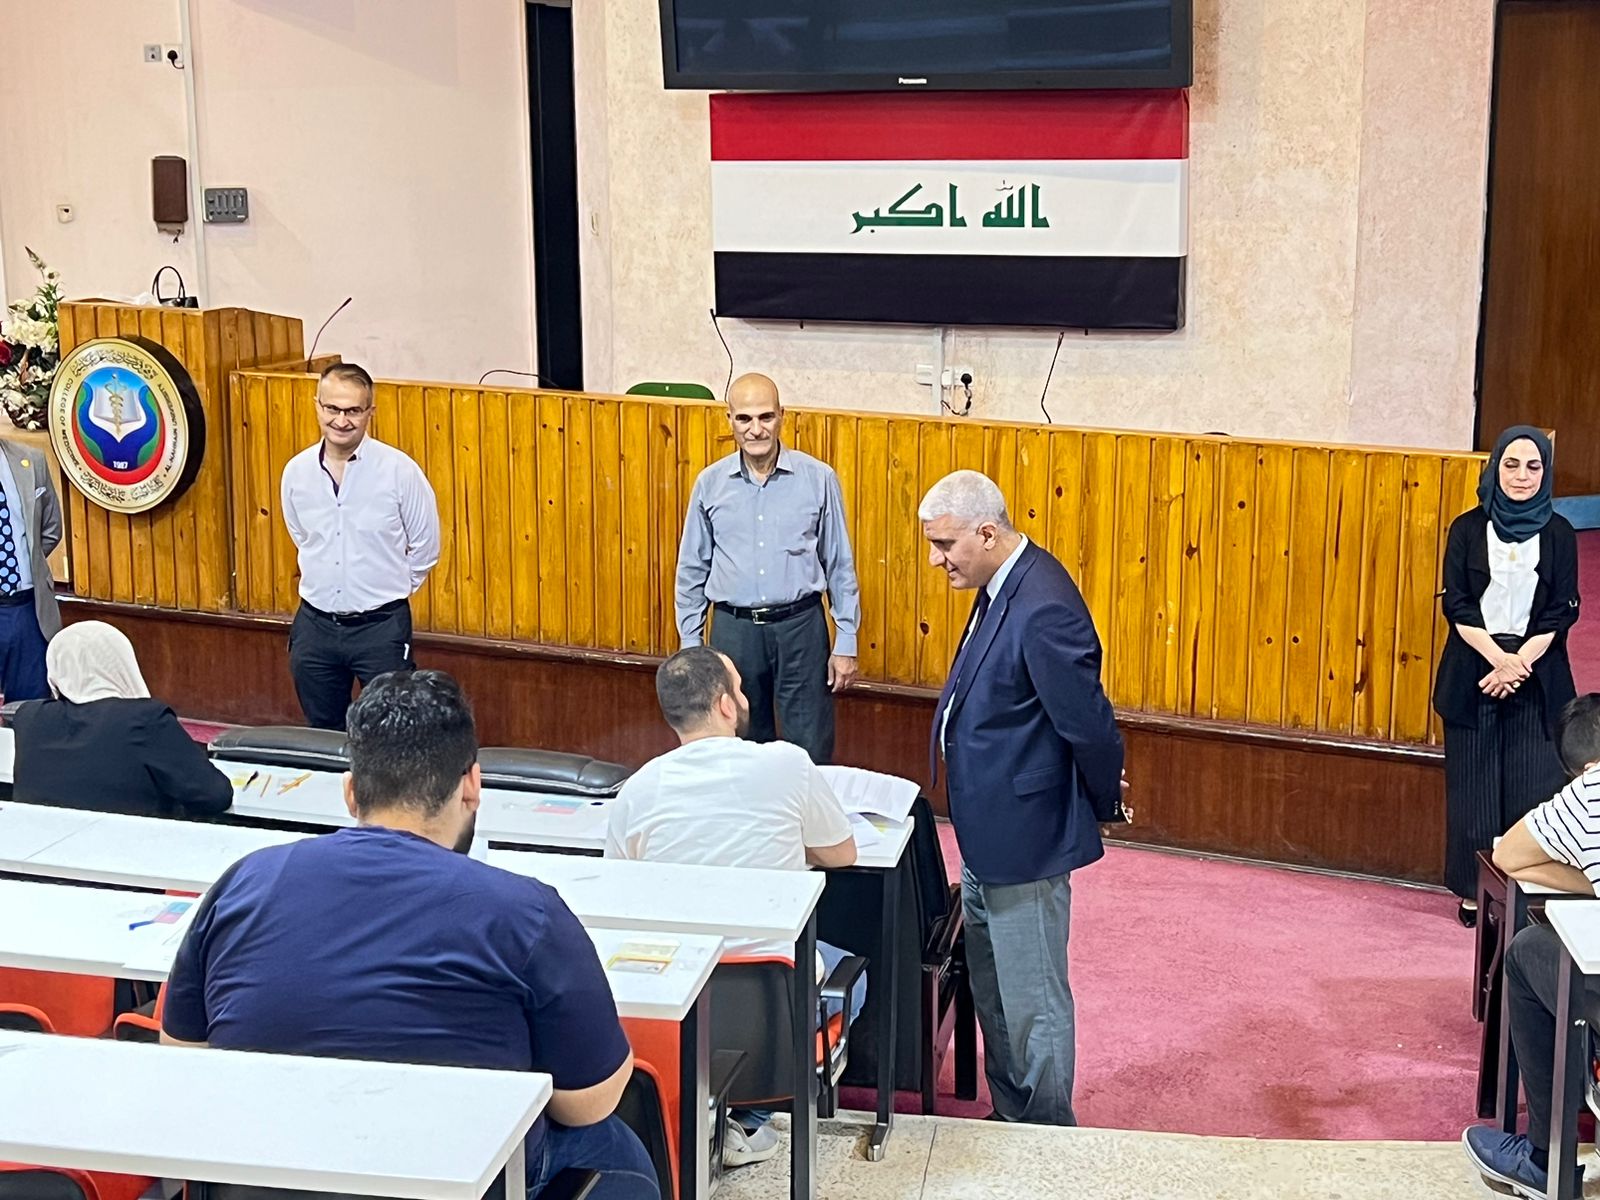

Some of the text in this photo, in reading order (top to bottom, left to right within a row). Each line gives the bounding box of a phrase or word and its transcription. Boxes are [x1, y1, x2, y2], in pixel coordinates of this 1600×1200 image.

[982, 180, 1050, 228] الله
[60, 377, 74, 414] COLLEGE
[59, 415, 67, 427] OF
